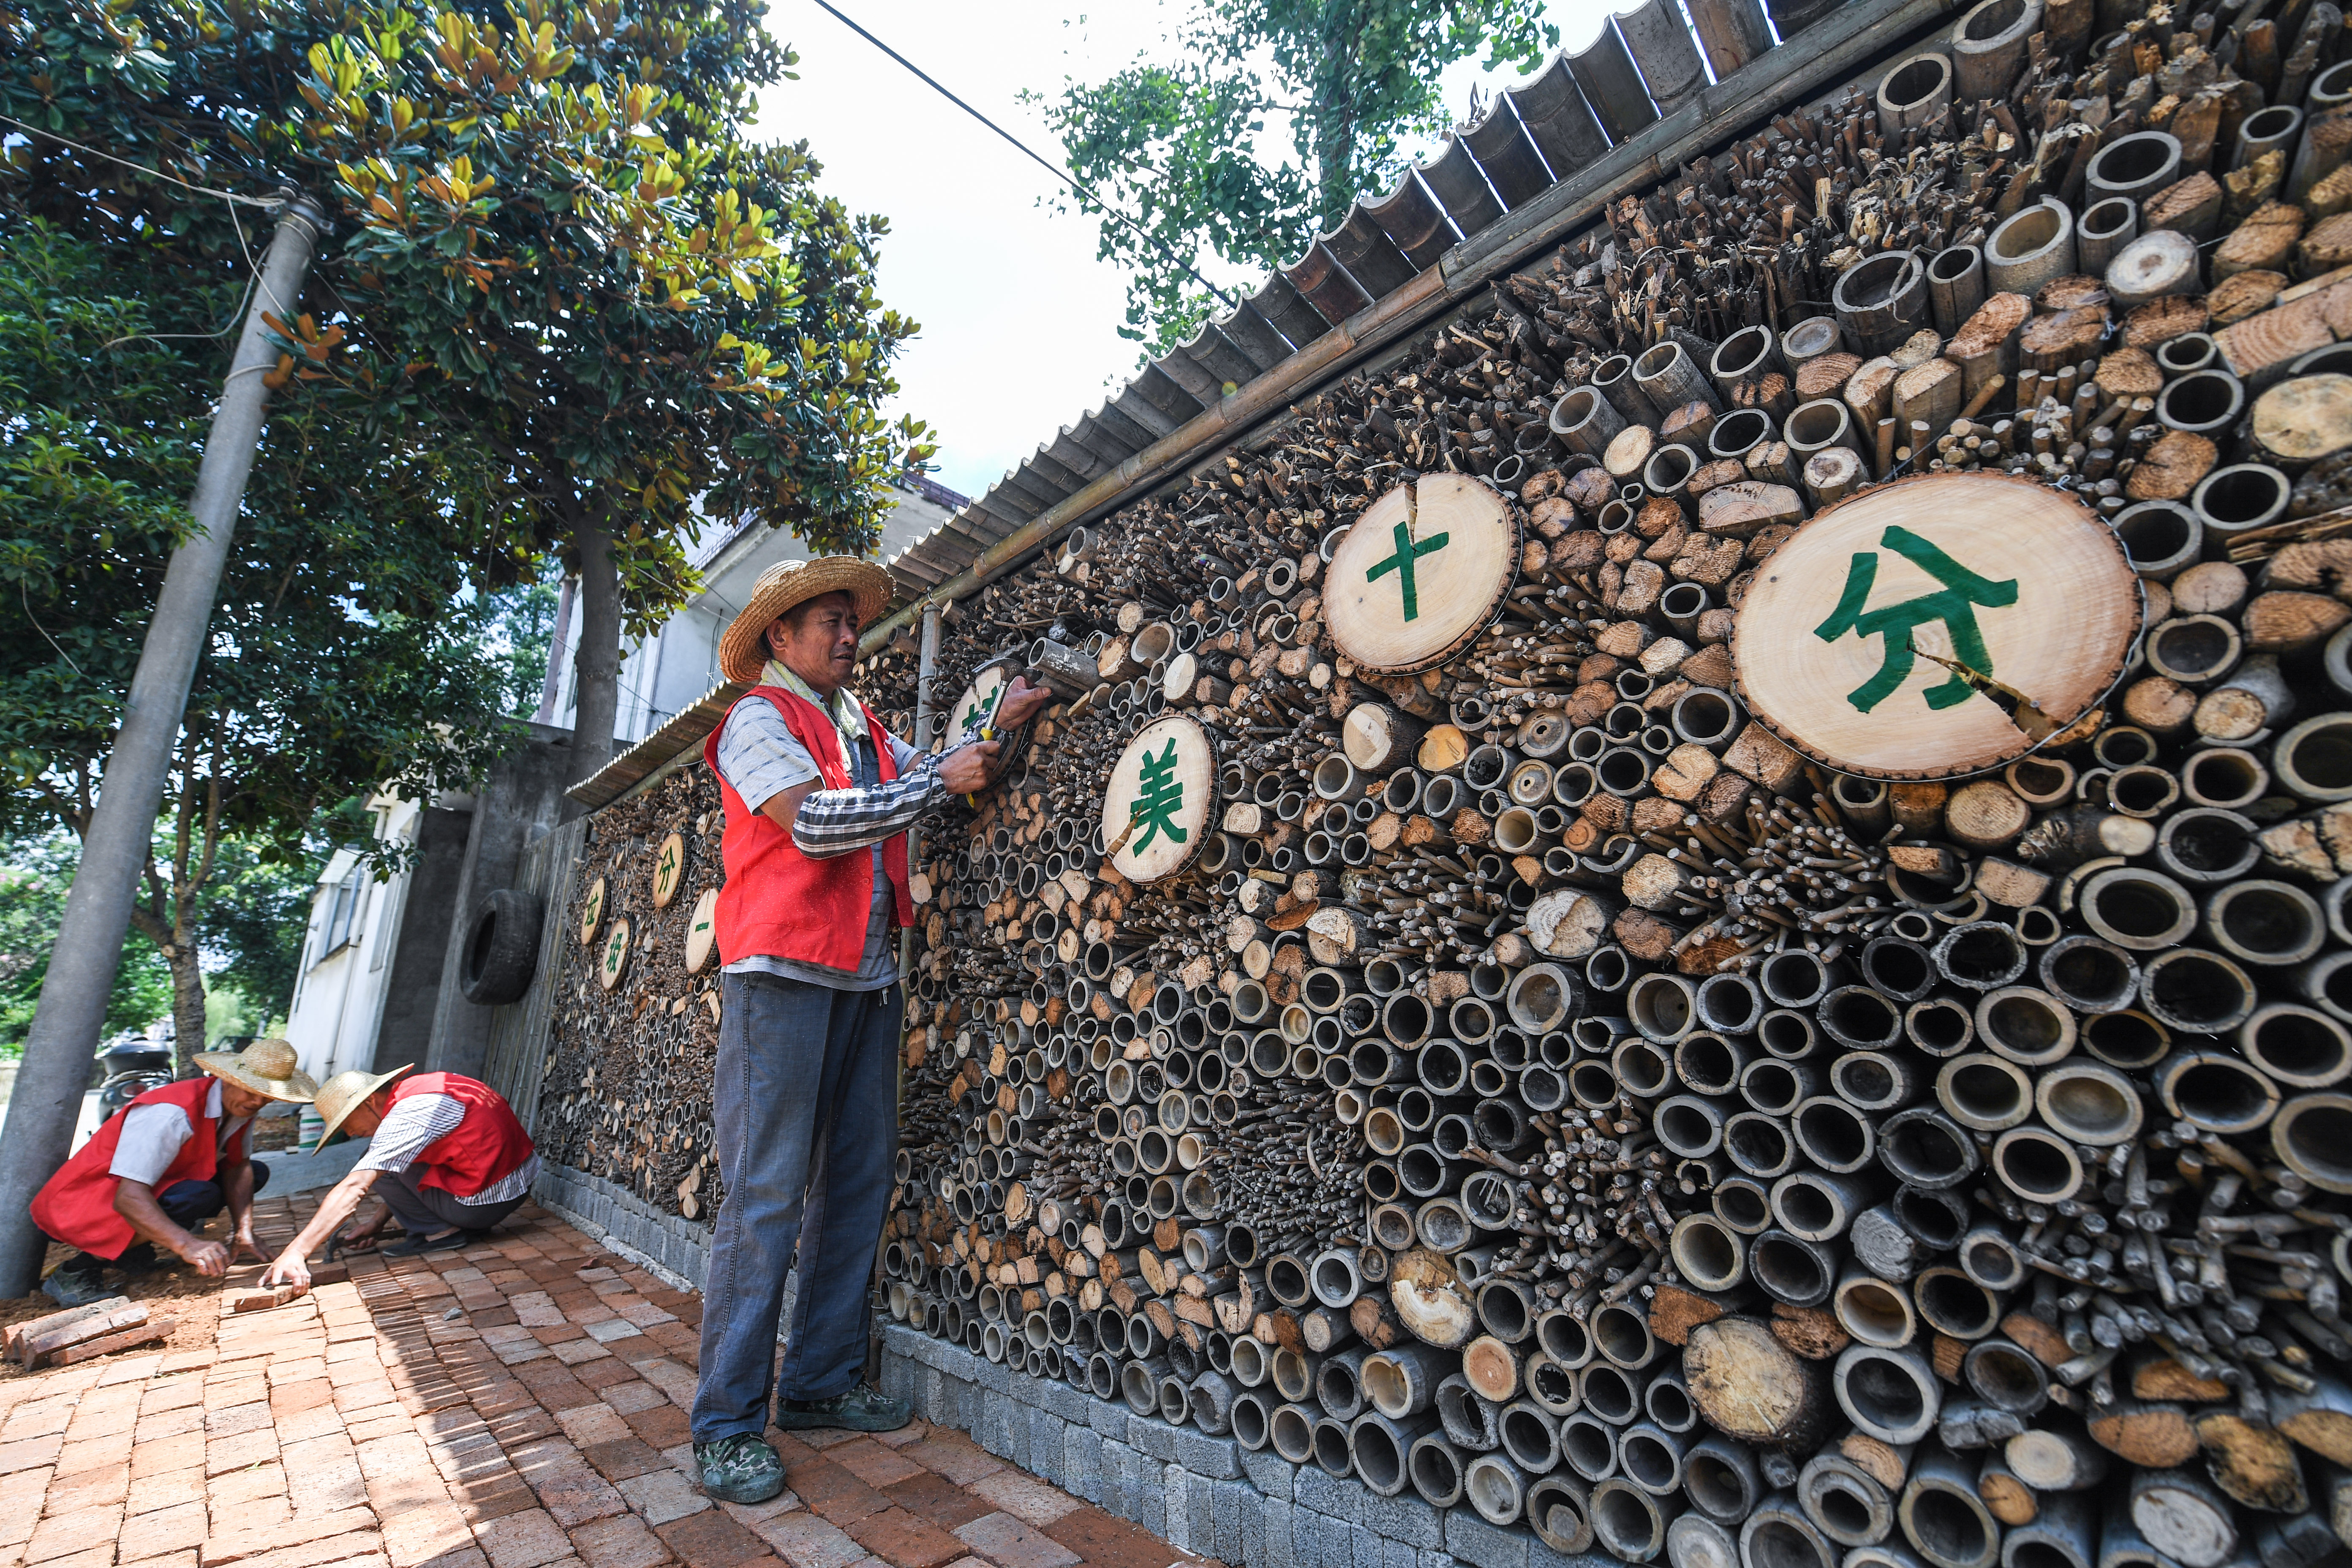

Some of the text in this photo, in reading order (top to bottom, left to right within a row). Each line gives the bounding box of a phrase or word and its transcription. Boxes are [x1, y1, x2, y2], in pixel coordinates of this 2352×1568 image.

[1366, 521, 1449, 622] 十
[1813, 525, 2018, 713] 分
[1130, 737, 1187, 858] 美
[658, 845, 675, 894] 分
[585, 890, 599, 926] 垃
[695, 922, 710, 933] 一
[606, 933, 623, 974] 圾
